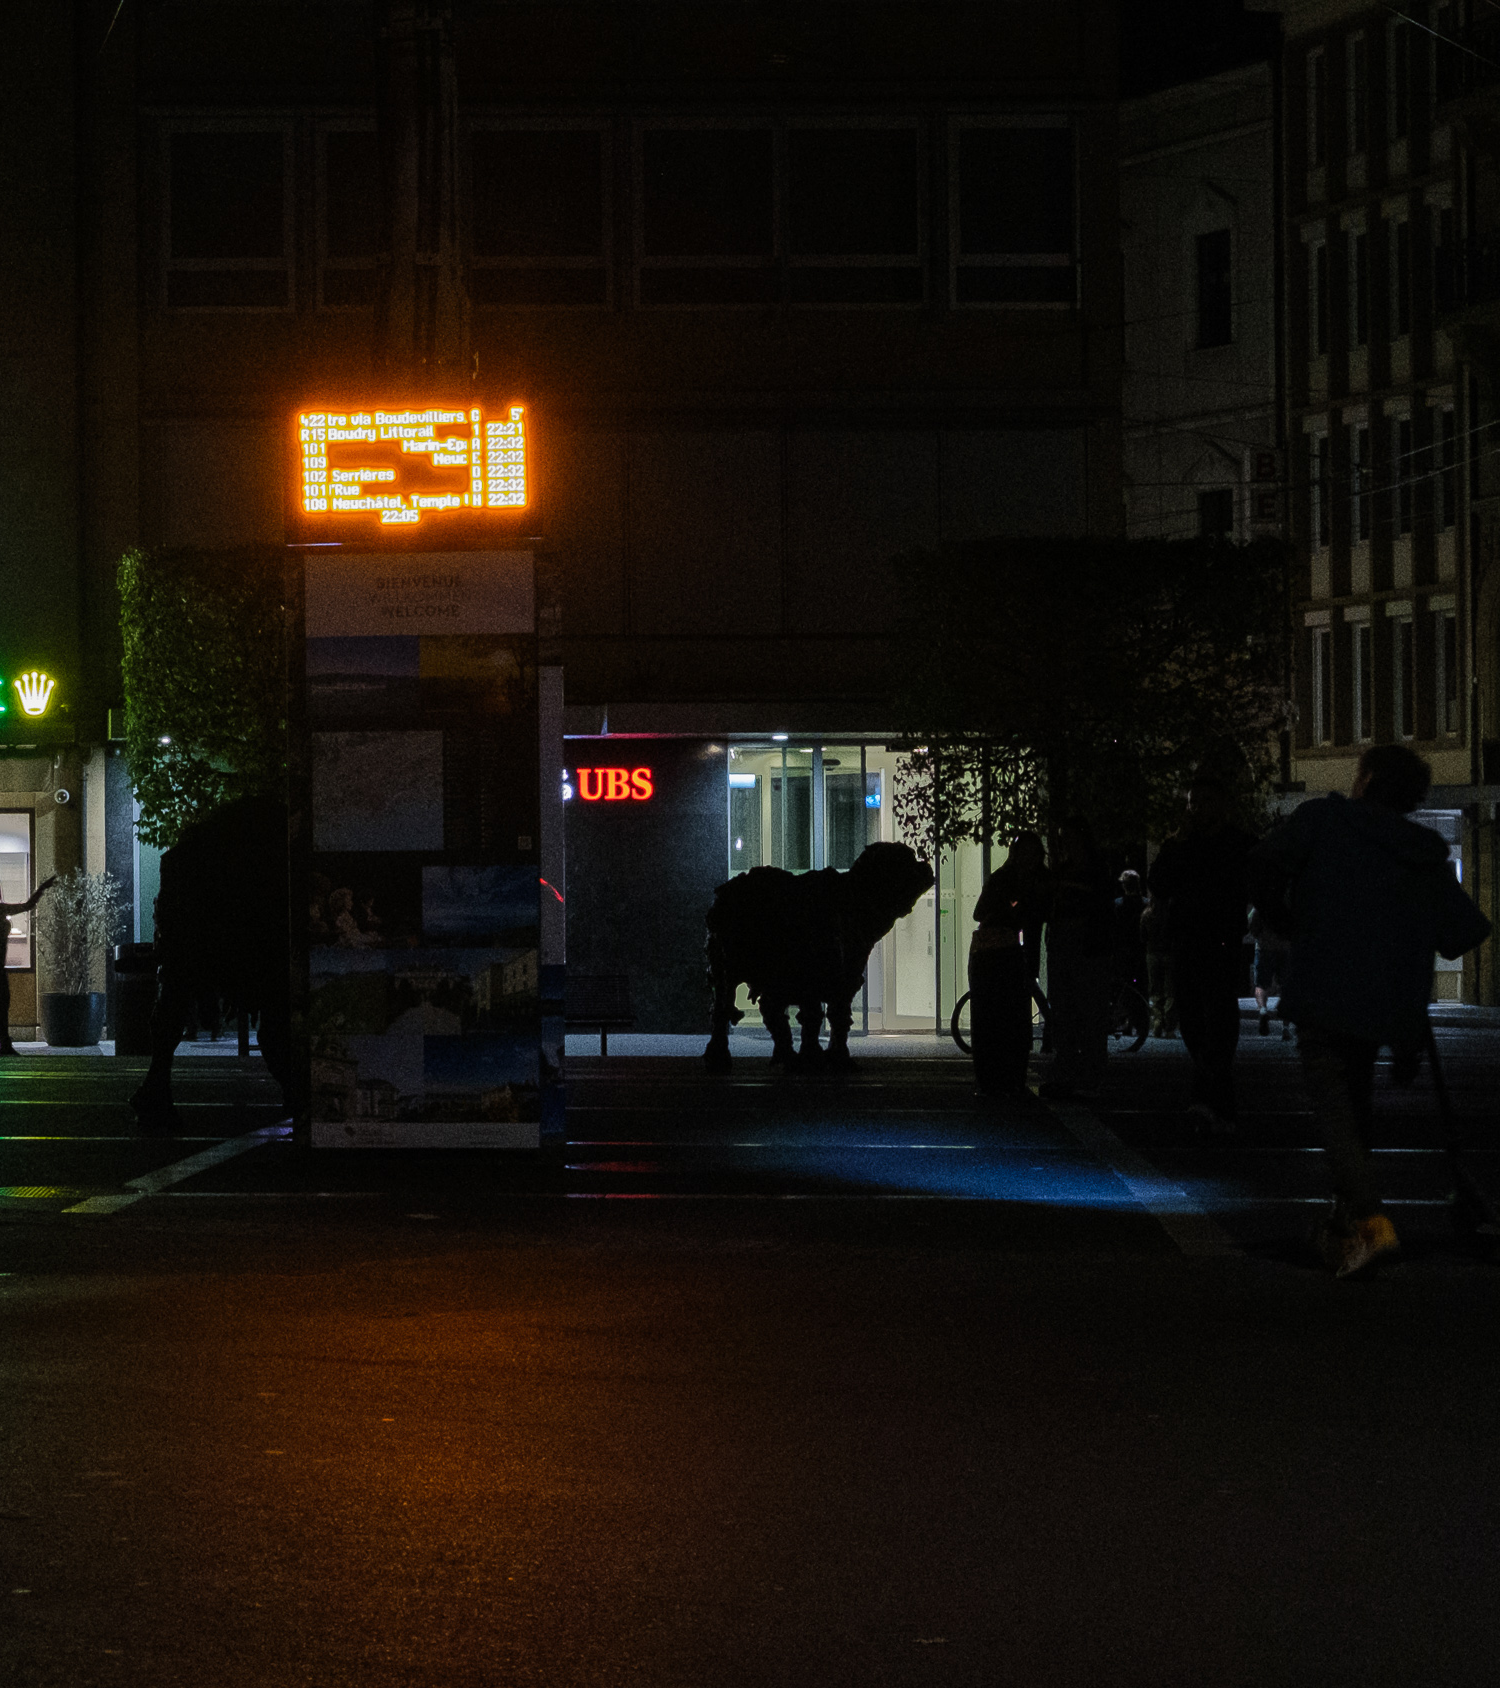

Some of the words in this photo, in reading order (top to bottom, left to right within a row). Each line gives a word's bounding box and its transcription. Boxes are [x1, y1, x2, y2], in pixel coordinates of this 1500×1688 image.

[301, 414, 326, 427] 422
[351, 413, 371, 425] via
[301, 428, 326, 441] R15
[328, 427, 376, 441] Boudry
[380, 425, 434, 438] Littorail
[473, 423, 479, 436] 1
[487, 422, 523, 435] 22:21
[303, 442, 325, 455] 101
[472, 438, 480, 450] A
[487, 436, 524, 449] 22:32
[303, 456, 326, 469] 109
[472, 452, 480, 464] E
[488, 450, 524, 463] 22:32
[304, 470, 326, 483] 102
[488, 464, 524, 477] 22:32
[304, 484, 326, 497] 101
[472, 479, 482, 492] B
[488, 478, 524, 491] 22:32
[333, 496, 406, 510] Neuchâtel,
[411, 494, 460, 509] Temple
[472, 493, 481, 506] H
[488, 492, 525, 506] 22:32
[382, 509, 419, 523] 22:05
[381, 604, 460, 618] WELCOME
[577, 767, 653, 800] UBS
